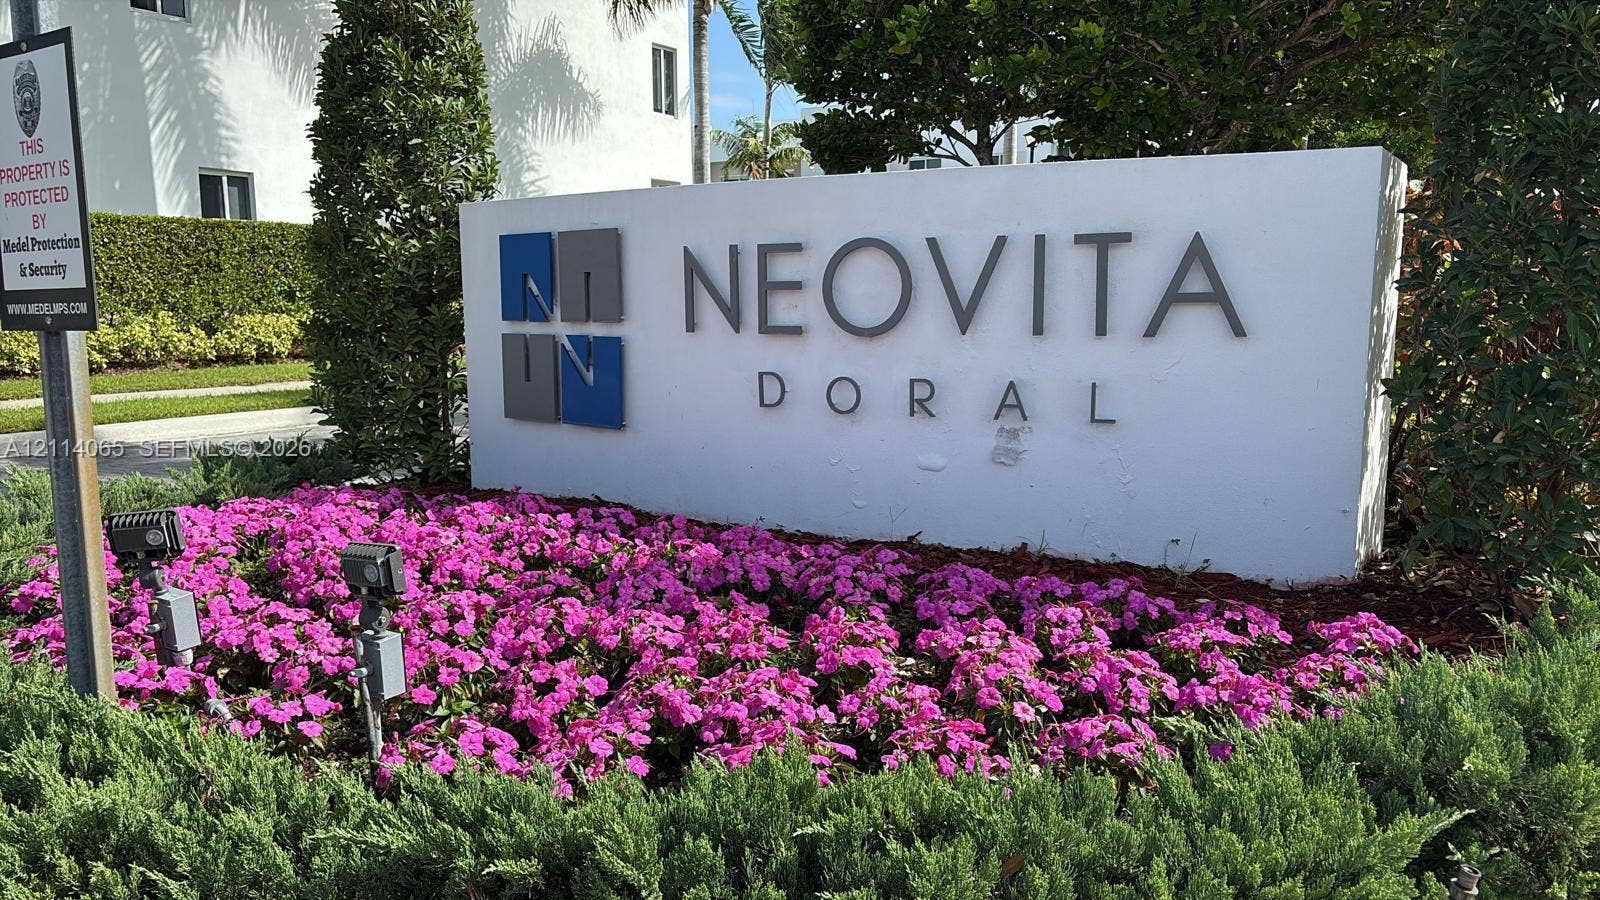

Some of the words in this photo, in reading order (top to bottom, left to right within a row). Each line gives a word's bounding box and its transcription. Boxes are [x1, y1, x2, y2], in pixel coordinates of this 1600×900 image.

[19, 138, 44, 156] THIS
[0, 161, 56, 184] PROPERTY
[59, 159, 70, 177] IS
[4, 186, 69, 208] PROTECTED
[32, 213, 47, 229] BY
[2, 236, 29, 254] Medel
[30, 233, 80, 252] Protection
[19, 262, 28, 278] &
[29, 260, 67, 280] Security
[683, 231, 1248, 338] NEOVITA
[7, 302, 88, 315] WWW.MEDELMPS.COM
[757, 371, 1117, 425] DORAL
